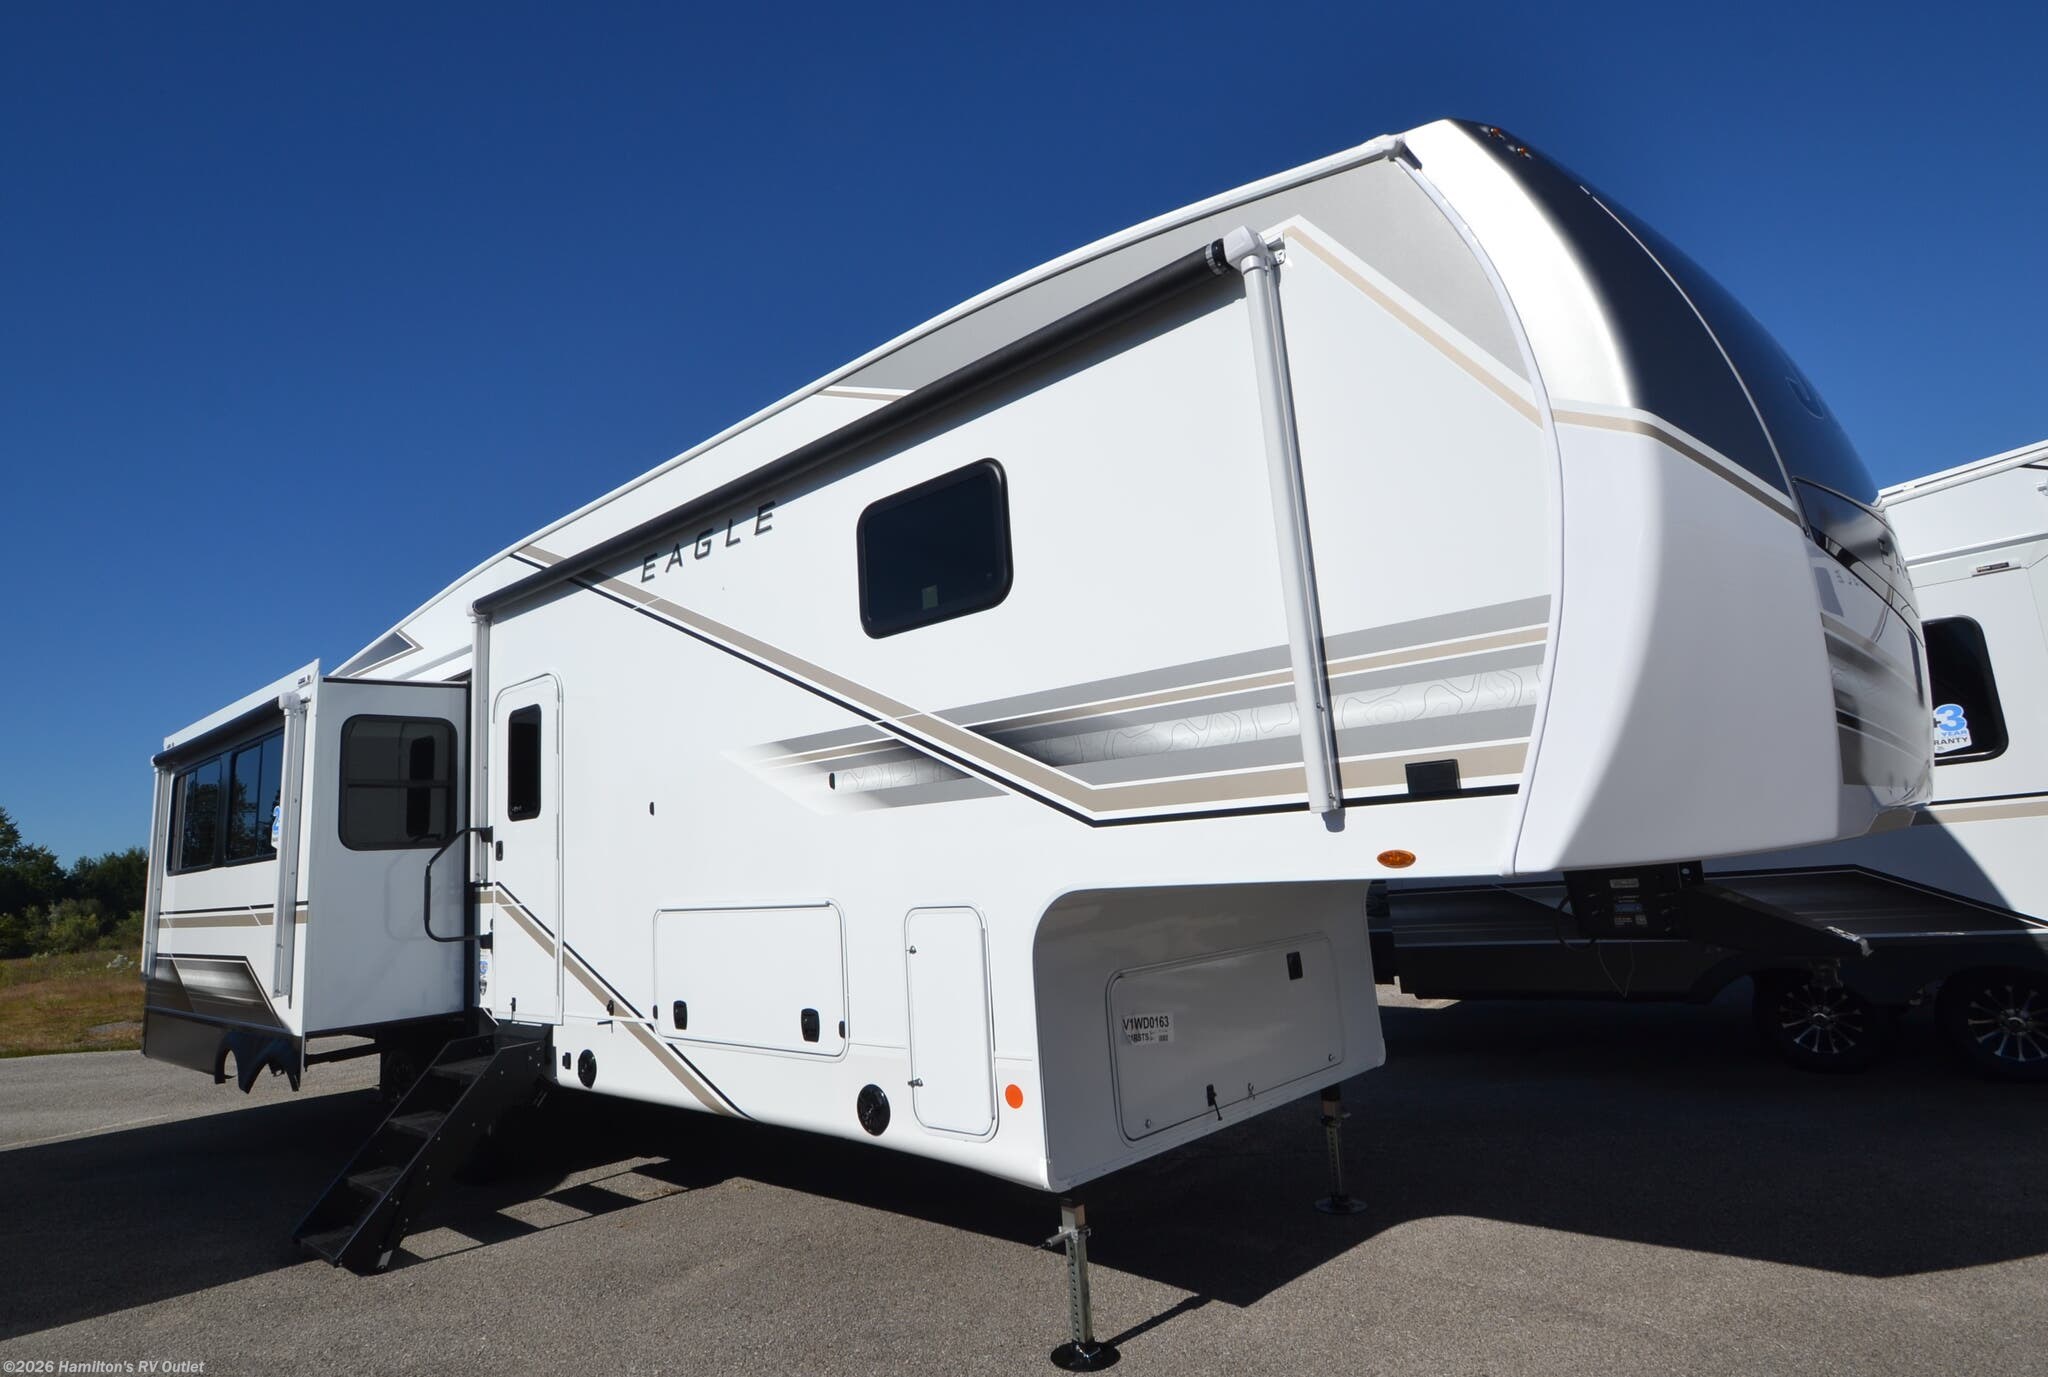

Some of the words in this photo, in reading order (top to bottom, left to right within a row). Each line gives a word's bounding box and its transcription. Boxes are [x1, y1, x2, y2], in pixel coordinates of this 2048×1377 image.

[641, 501, 776, 583] EAGLE
[1934, 737, 1967, 745] RANTY
[1122, 1016, 1169, 1030] V1WD0163
